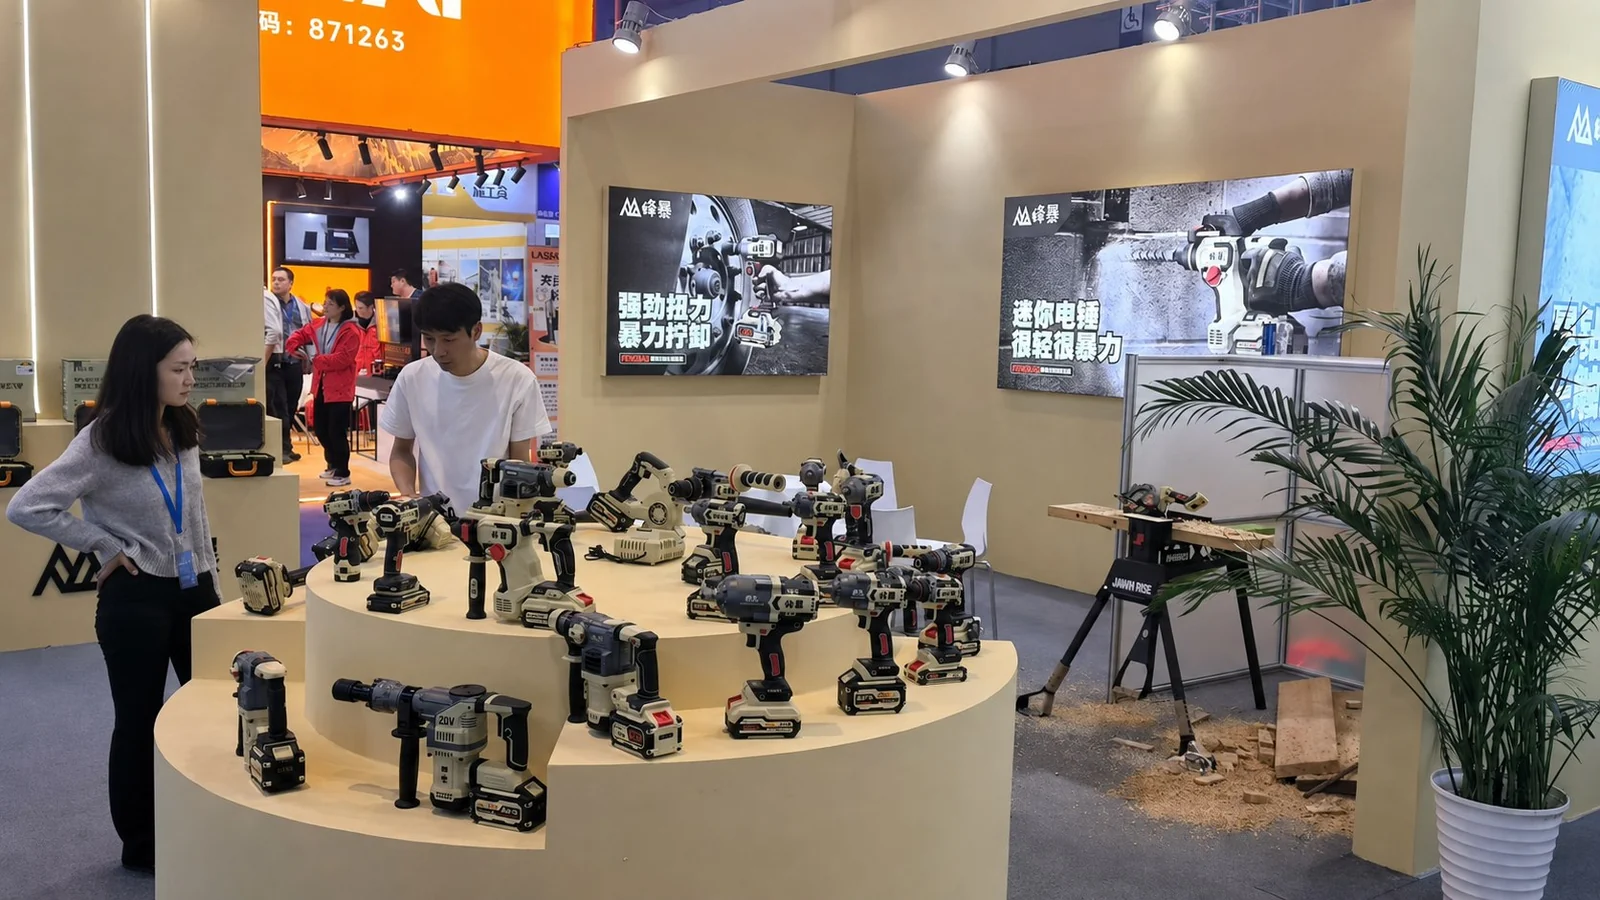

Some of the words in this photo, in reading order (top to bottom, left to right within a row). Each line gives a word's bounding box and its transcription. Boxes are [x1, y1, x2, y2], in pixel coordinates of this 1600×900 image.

[309, 18, 405, 52] 871263
[641, 198, 672, 219] 锋暴
[1031, 203, 1060, 224] 锋暴
[618, 291, 711, 321] 强劲扭力
[1012, 299, 1100, 330] 迷你电锤
[618, 321, 711, 350] 暴力拧卸
[1011, 329, 1122, 364] 很轻很暴力
